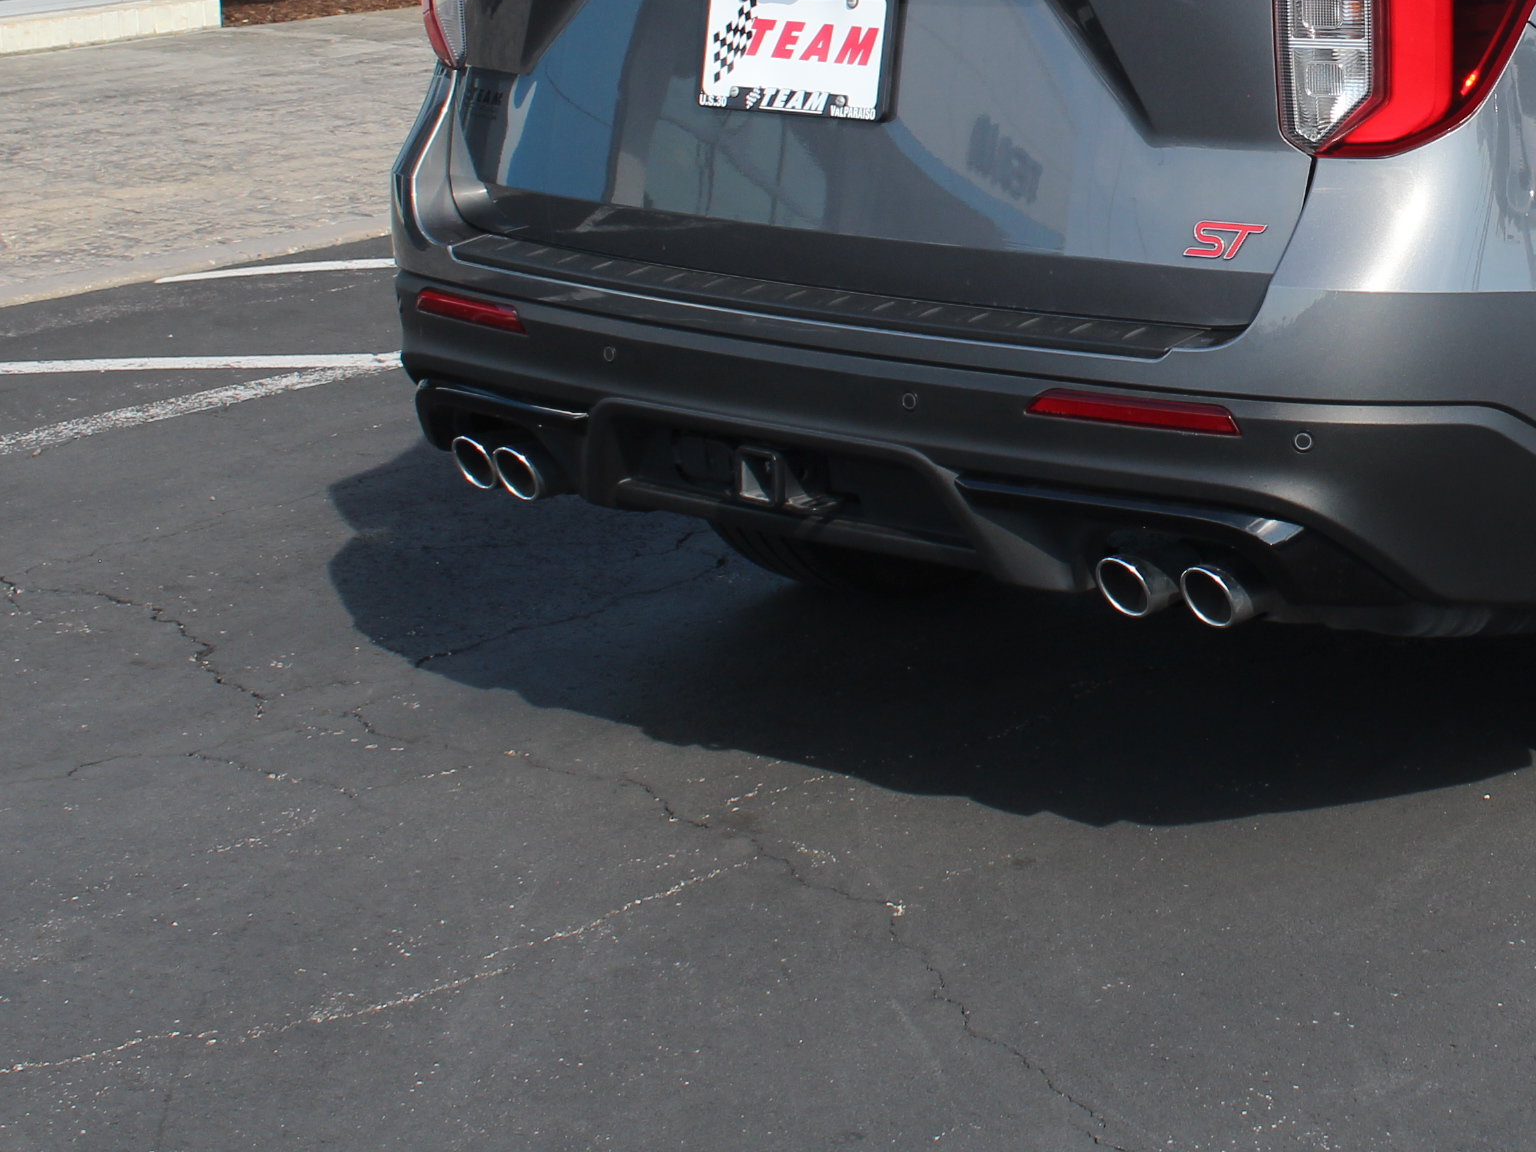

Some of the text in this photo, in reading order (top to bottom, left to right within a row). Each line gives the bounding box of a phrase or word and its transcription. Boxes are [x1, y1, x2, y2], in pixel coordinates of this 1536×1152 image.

[746, 17, 880, 66] TEAM
[758, 87, 831, 112] TEAM
[830, 105, 876, 121] VALPARAISO
[1183, 219, 1268, 260] ST
